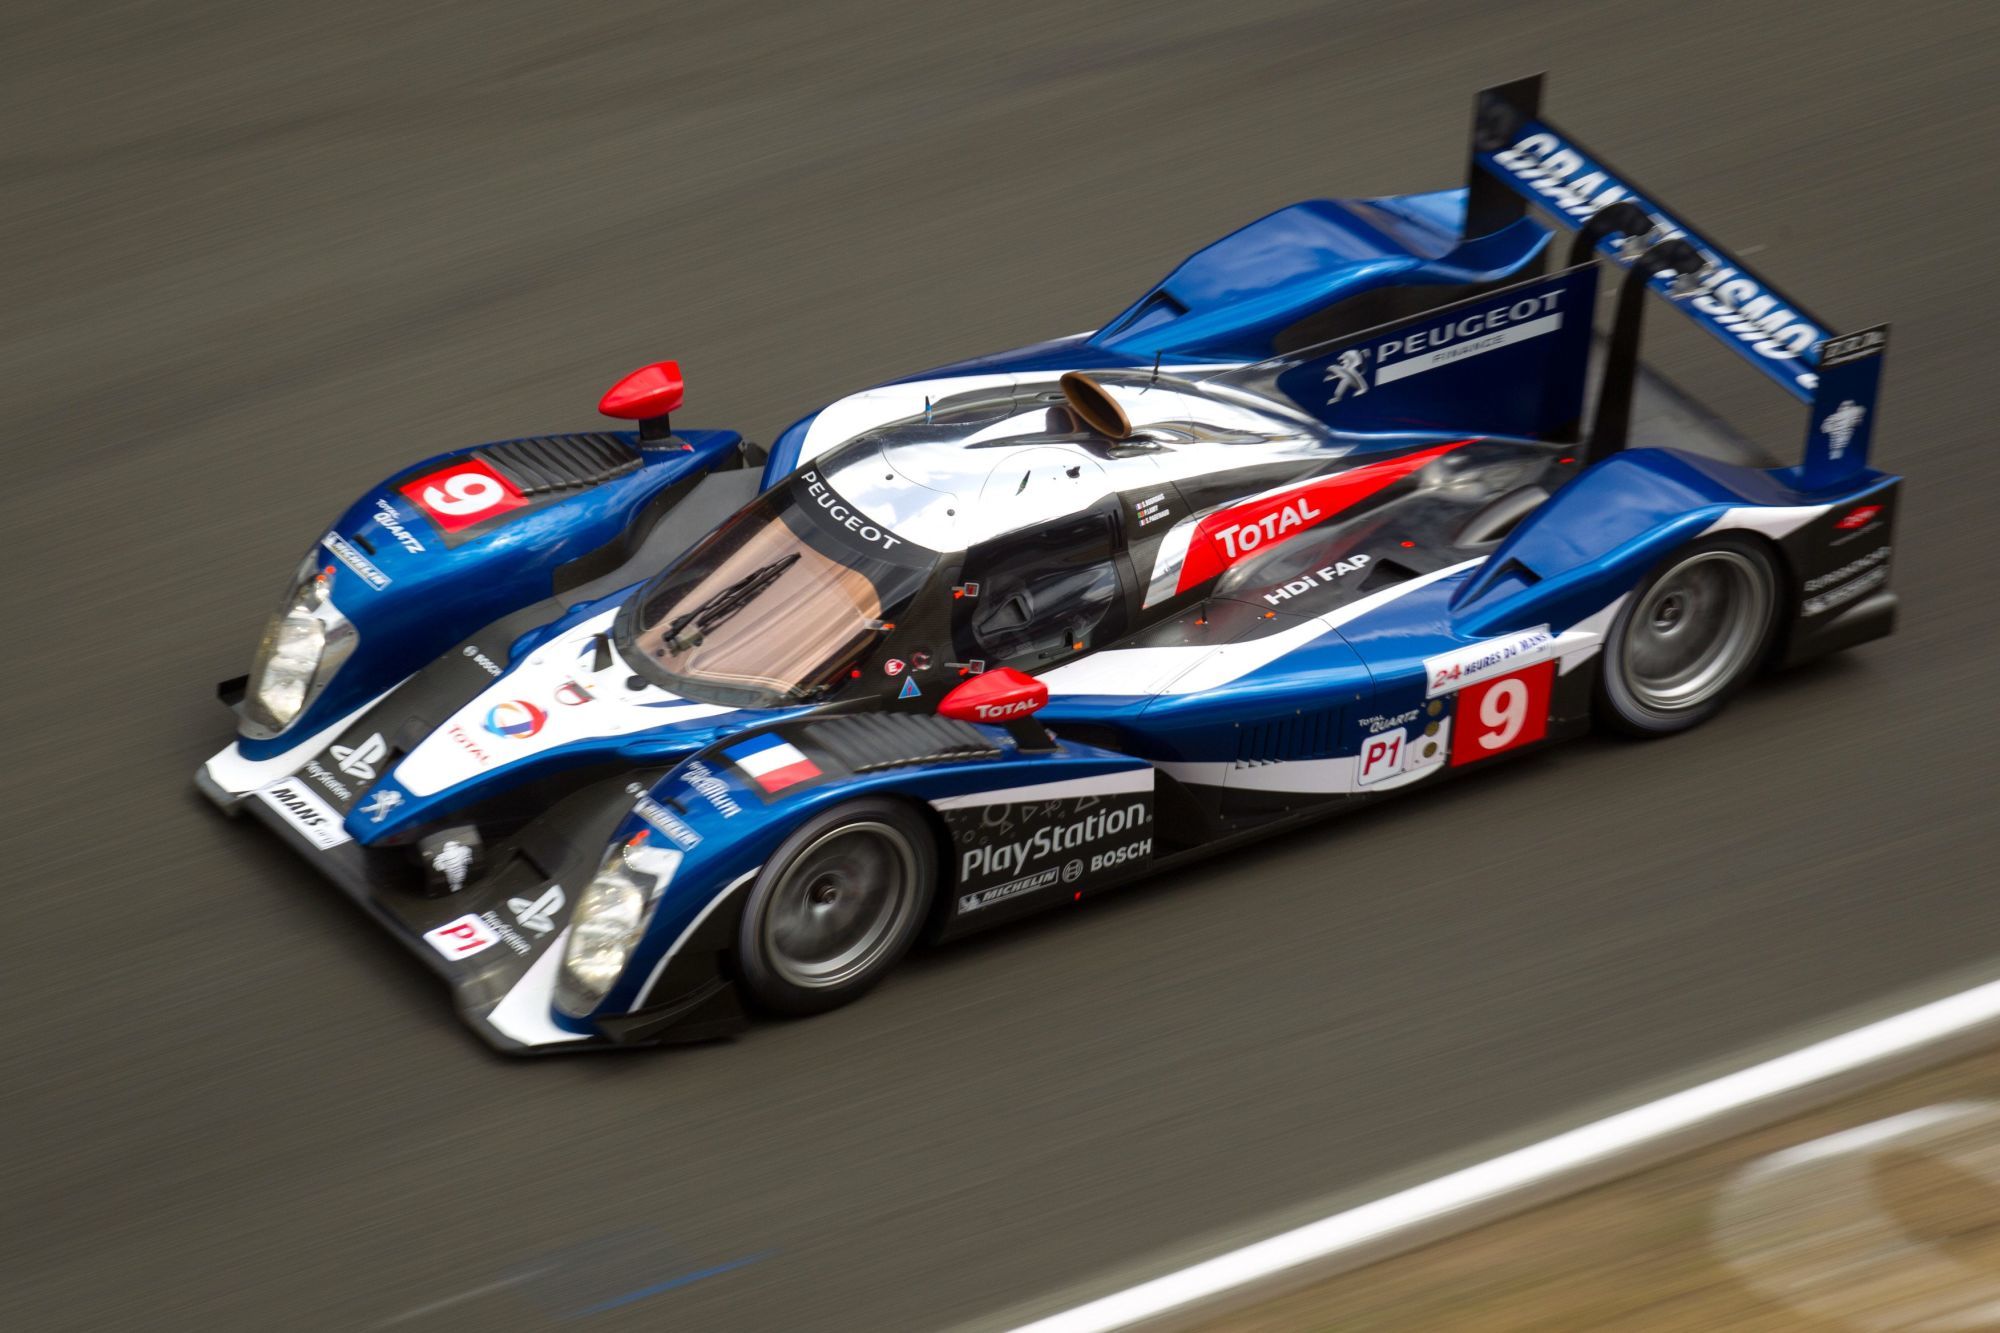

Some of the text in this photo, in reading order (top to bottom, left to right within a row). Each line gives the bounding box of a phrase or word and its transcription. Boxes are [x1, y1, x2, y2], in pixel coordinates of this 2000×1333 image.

[1376, 288, 1568, 364] PEUGEOT
[423, 472, 506, 516] 9
[801, 470, 902, 551] PEUGEOT
[372, 512, 425, 554] QUARTZ
[1263, 553, 1372, 606] HDi FAP
[1431, 663, 1463, 690] 24
[1463, 652, 1502, 676] HEURES
[1370, 709, 1420, 733] QUARTZ
[1478, 677, 1529, 750] 9
[449, 724, 492, 763] TOTAL
[1363, 735, 1402, 776] P1
[271, 788, 328, 826] MANS
[961, 802, 1146, 882] PlayStation
[1090, 838, 1152, 872] BOSCH
[982, 868, 1056, 902] MICHELIN
[438, 922, 489, 952] P1
